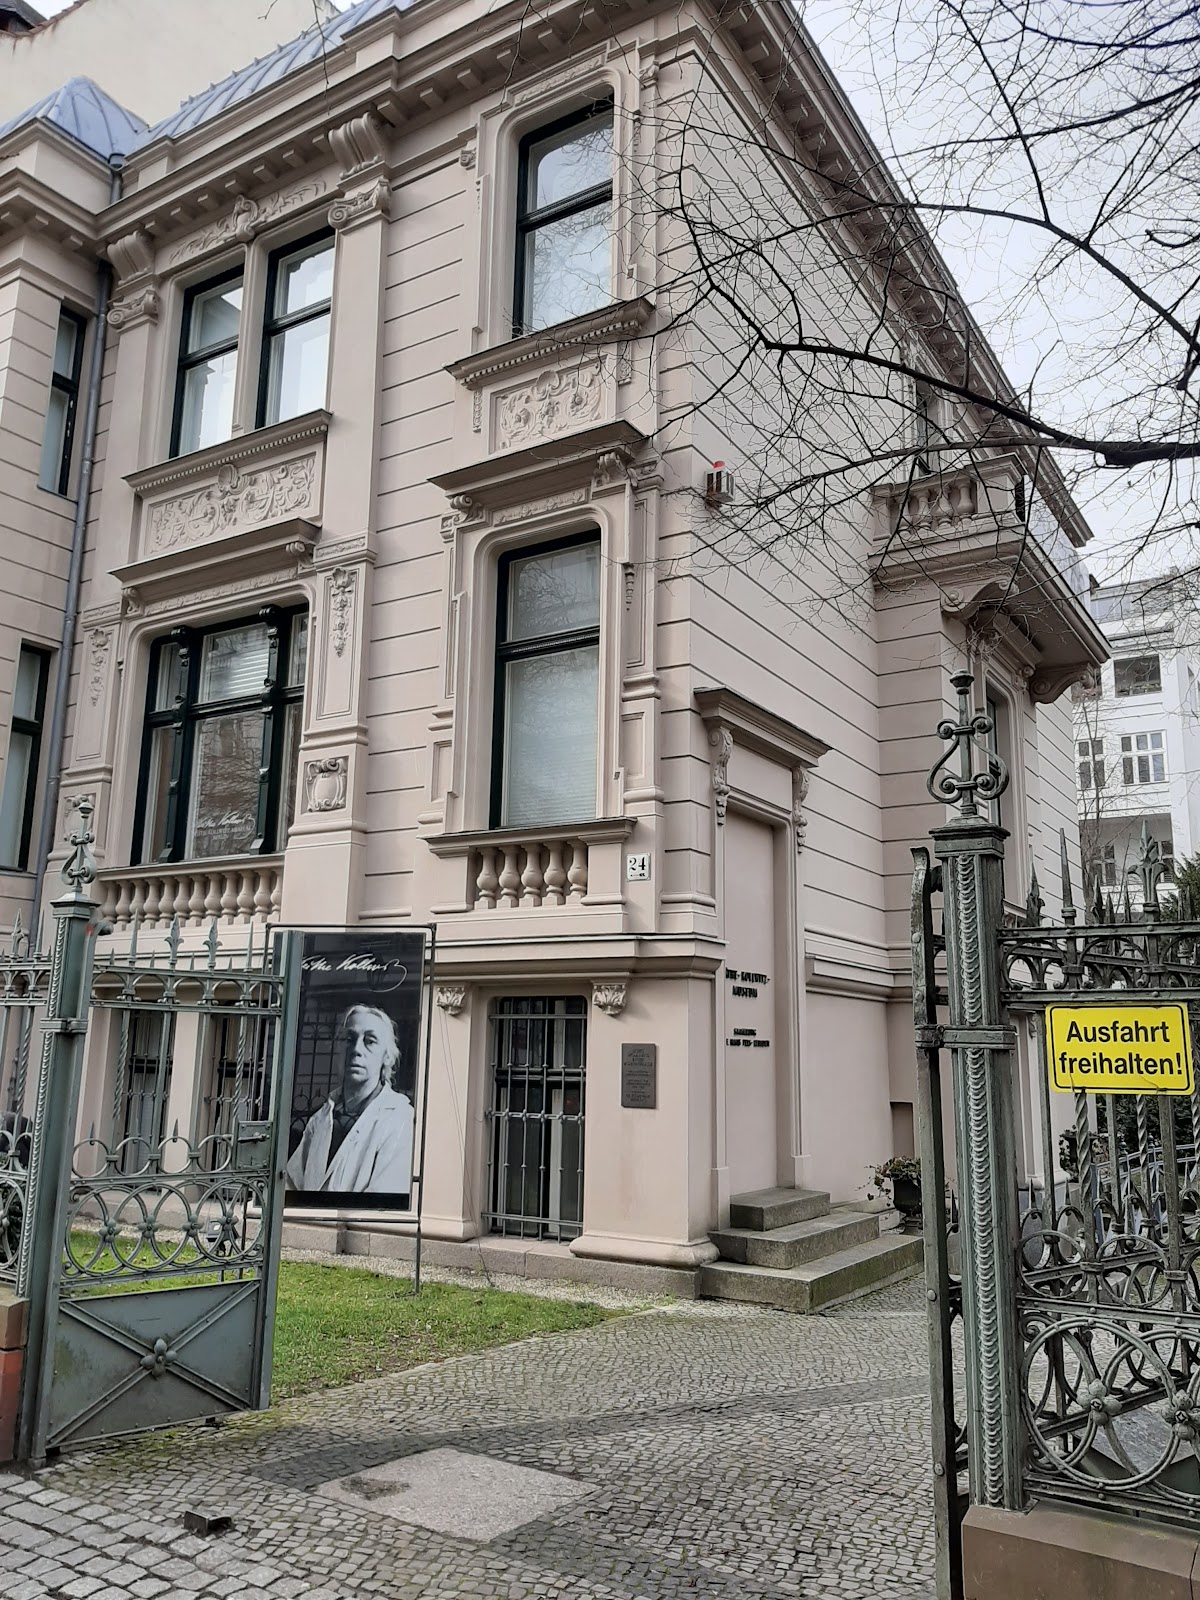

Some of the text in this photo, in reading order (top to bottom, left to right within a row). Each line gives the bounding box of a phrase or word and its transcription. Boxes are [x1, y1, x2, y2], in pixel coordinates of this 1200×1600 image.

[629, 856, 647, 871] 24
[1066, 1020, 1170, 1043] Ausfahrt
[1058, 1051, 1183, 1075] freihalten!
